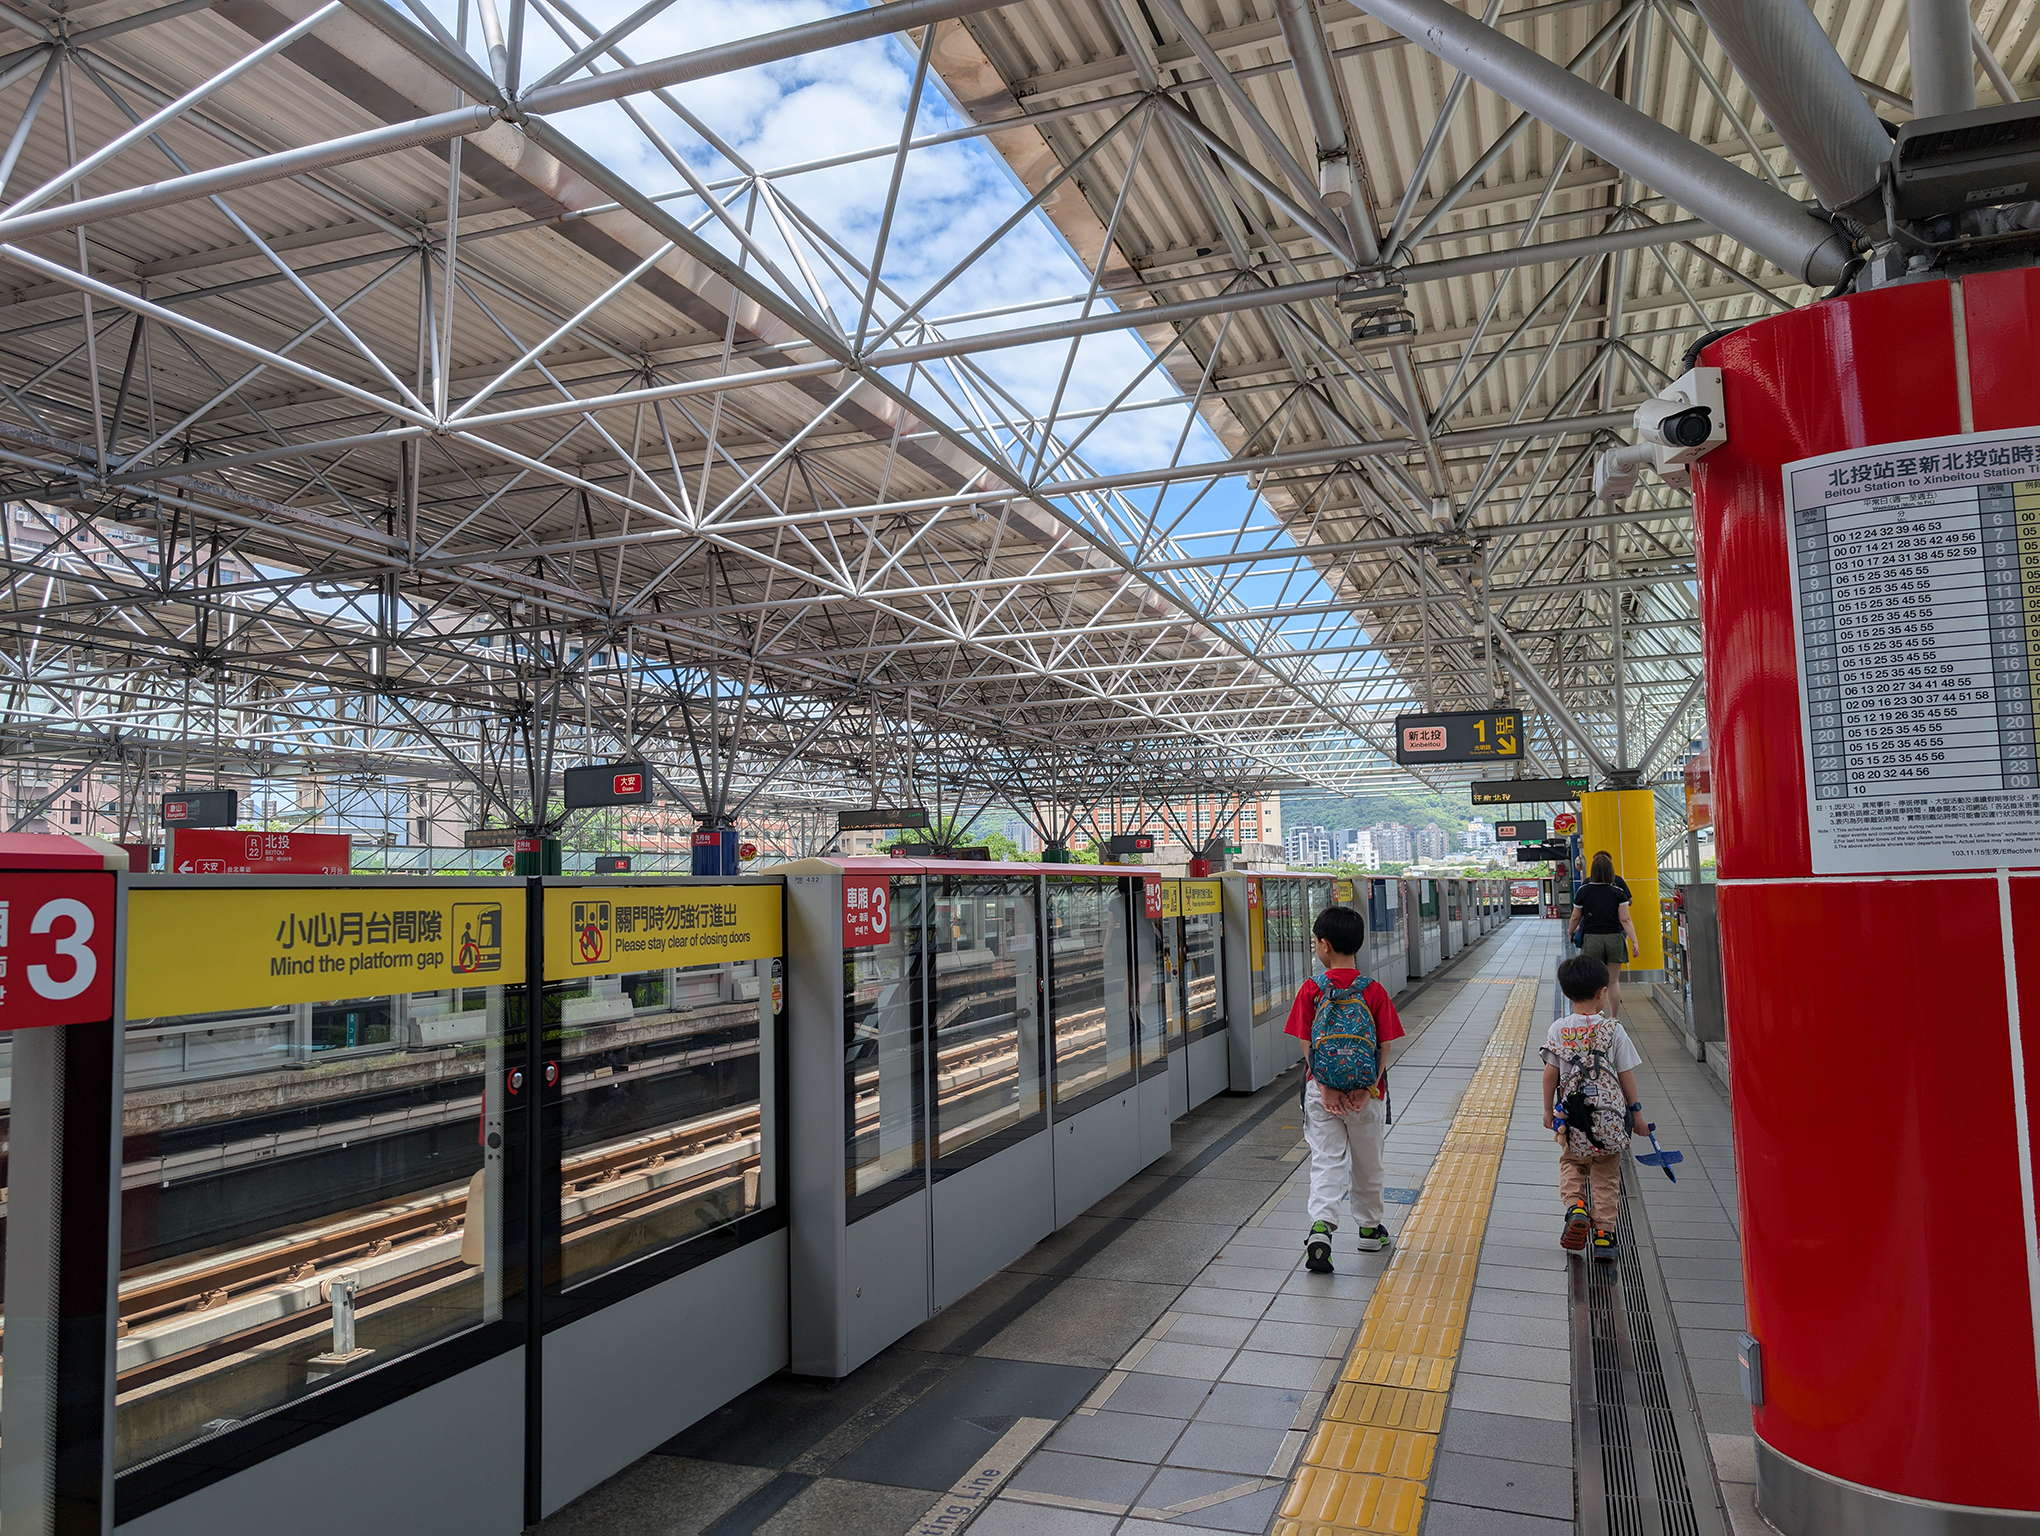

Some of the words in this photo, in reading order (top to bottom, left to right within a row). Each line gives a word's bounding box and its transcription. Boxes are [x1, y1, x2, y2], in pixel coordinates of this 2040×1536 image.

[1828, 445, 2040, 487] 北投站至新北投站時
[1825, 484, 1861, 499] Beitou
[1864, 478, 1905, 493] Station
[1909, 478, 1920, 487] to
[1924, 471, 1979, 484] Xinbeitou
[1983, 467, 2025, 478] Station
[1832, 533, 1846, 543] 00
[1848, 531, 1862, 541] 12
[1864, 529, 1878, 539] 24
[1880, 527, 1894, 537] 32
[1896, 525, 1910, 535] 39
[1912, 523, 1926, 533] 46
[1928, 521, 1942, 531] 53
[1807, 538, 1816, 549] 6
[1834, 547, 1847, 557] 00
[1850, 545, 1863, 555] 07
[1866, 543, 1879, 553] 14
[1882, 541, 1895, 551] 21
[1898, 539, 1911, 549] 28
[1914, 537, 1927, 547] 35
[1930, 535, 1944, 545] 42
[1946, 533, 1960, 543] 49
[1962, 532, 1976, 542] 56
[1808, 551, 1817, 562] 7
[1835, 561, 1848, 571] 03
[1851, 559, 1864, 569] 10
[1867, 557, 1880, 567] 17
[1883, 555, 1896, 565] 24
[1899, 553, 1912, 563] 31
[1915, 552, 1929, 562] 38
[1931, 550, 1945, 560] 45
[1947, 548, 1961, 558] 52
[1963, 546, 1977, 556] 59
[1809, 565, 1818, 576] 8
[1814, 675, 1831, 686] 16
[1843, 672, 1857, 682] 05
[1859, 670, 1873, 680] 15
[1876, 669, 1889, 679] 25
[1892, 668, 1905, 678] 35
[1908, 666, 1921, 676] 45
[1924, 665, 1937, 675] 52
[1940, 664, 1954, 674] 59
[1815, 688, 1832, 700] 17
[1845, 686, 1858, 696] 06
[1861, 685, 1874, 695] 13
[1877, 684, 1891, 694] 20
[1893, 682, 1907, 692] 27
[1909, 681, 1923, 691] 34
[1925, 680, 1939, 690] 41
[1942, 678, 1955, 688] 48
[1958, 677, 1971, 687] 55
[1816, 702, 1834, 714] 18
[1846, 700, 1859, 710] 02
[1862, 699, 1876, 709] 09
[1878, 698, 1892, 708] 16
[1894, 696, 1908, 706] 23
[1910, 695, 1924, 705] 30
[1927, 694, 1940, 704] 37
[1943, 693, 1956, 703] 44
[1959, 692, 1973, 702] 51
[1975, 690, 1989, 700] 58
[1408, 730, 1441, 741] 新北投
[1473, 720, 1485, 742] 1
[1496, 716, 1514, 735] 出口
[621, 777, 635, 786] 大安
[1822, 772, 1839, 783] 23
[1851, 770, 1865, 780] 08
[1867, 769, 1881, 779] 20
[1884, 768, 1897, 778] 32
[1900, 768, 1913, 778] 44
[1916, 767, 1930, 777] 56
[1823, 786, 1840, 797] 00
[1853, 785, 1866, 795] 10
[265, 835, 290, 849] 北投
[249, 848, 260, 856] 22
[202, 862, 218, 871] 大安
[1155, 884, 1161, 911] 3
[1252, 883, 1257, 904] 3
[615, 903, 737, 934] 關門時勿強行進出
[847, 887, 868, 909] 車廂
[872, 887, 886, 933] 3
[847, 913, 857, 923] Car
[276, 910, 443, 949] 小心月台間隙
[27, 898, 97, 1000] 3
[615, 938, 645, 952] Please
[647, 936, 666, 952] stay
[668, 935, 689, 949] clear
[690, 933, 698, 947] of
[699, 932, 728, 947] closing
[729, 931, 750, 943] doors
[270, 955, 314, 976] Mind
[319, 954, 346, 973] the
[350, 951, 413, 976] platform
[417, 951, 444, 970] gap
[1563, 1038, 1596, 1053] AR
[954, 1468, 1001, 1500] Line
